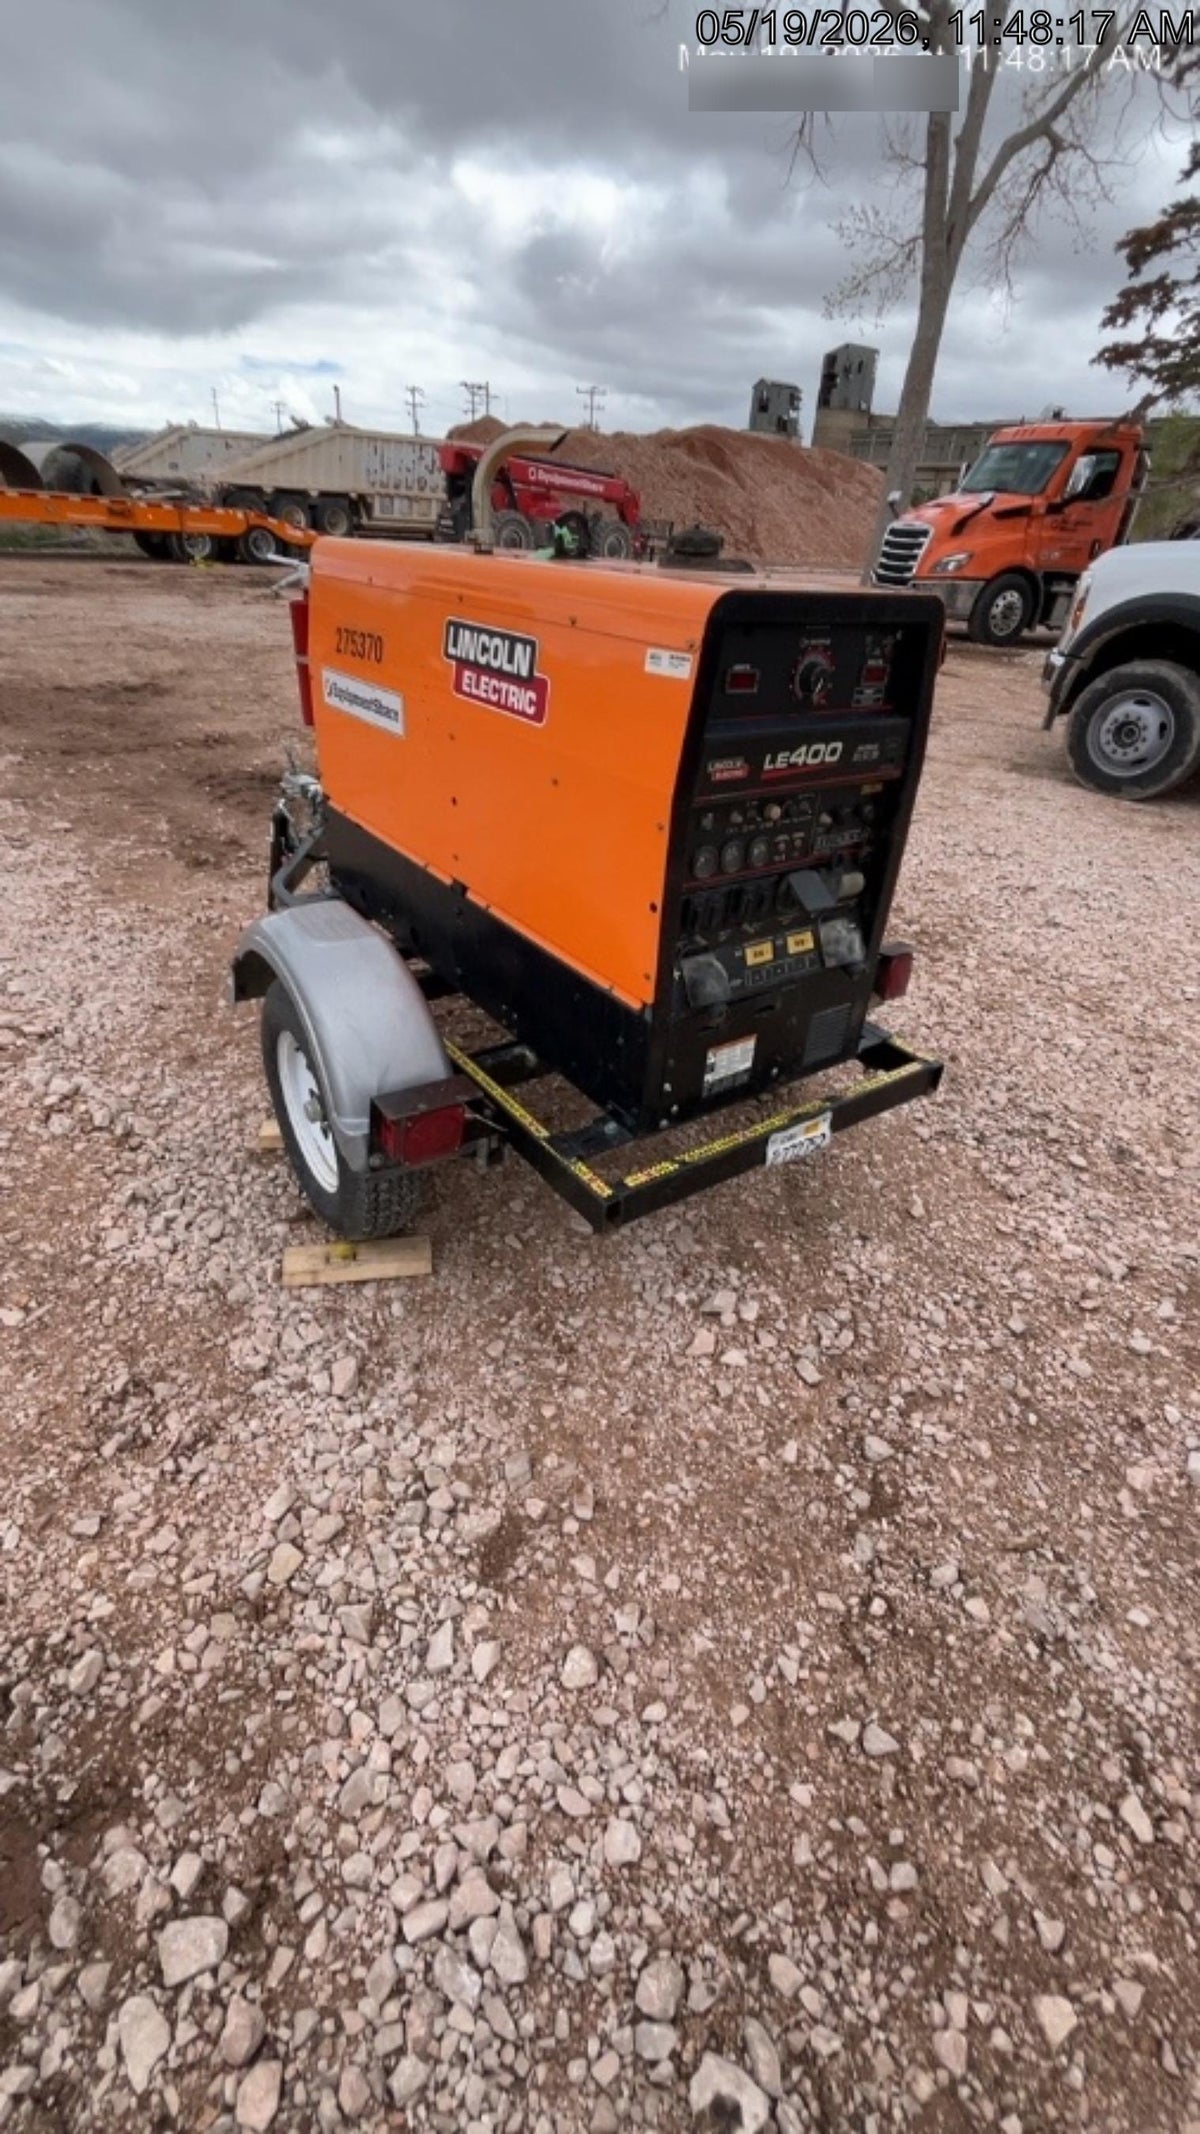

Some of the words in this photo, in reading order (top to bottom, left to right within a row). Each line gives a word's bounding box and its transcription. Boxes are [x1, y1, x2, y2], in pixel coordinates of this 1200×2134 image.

[336, 626, 384, 664] 275370
[447, 625, 532, 678] LINCOLN
[462, 669, 537, 715] ELECTRIC
[763, 741, 843, 771] LE400
